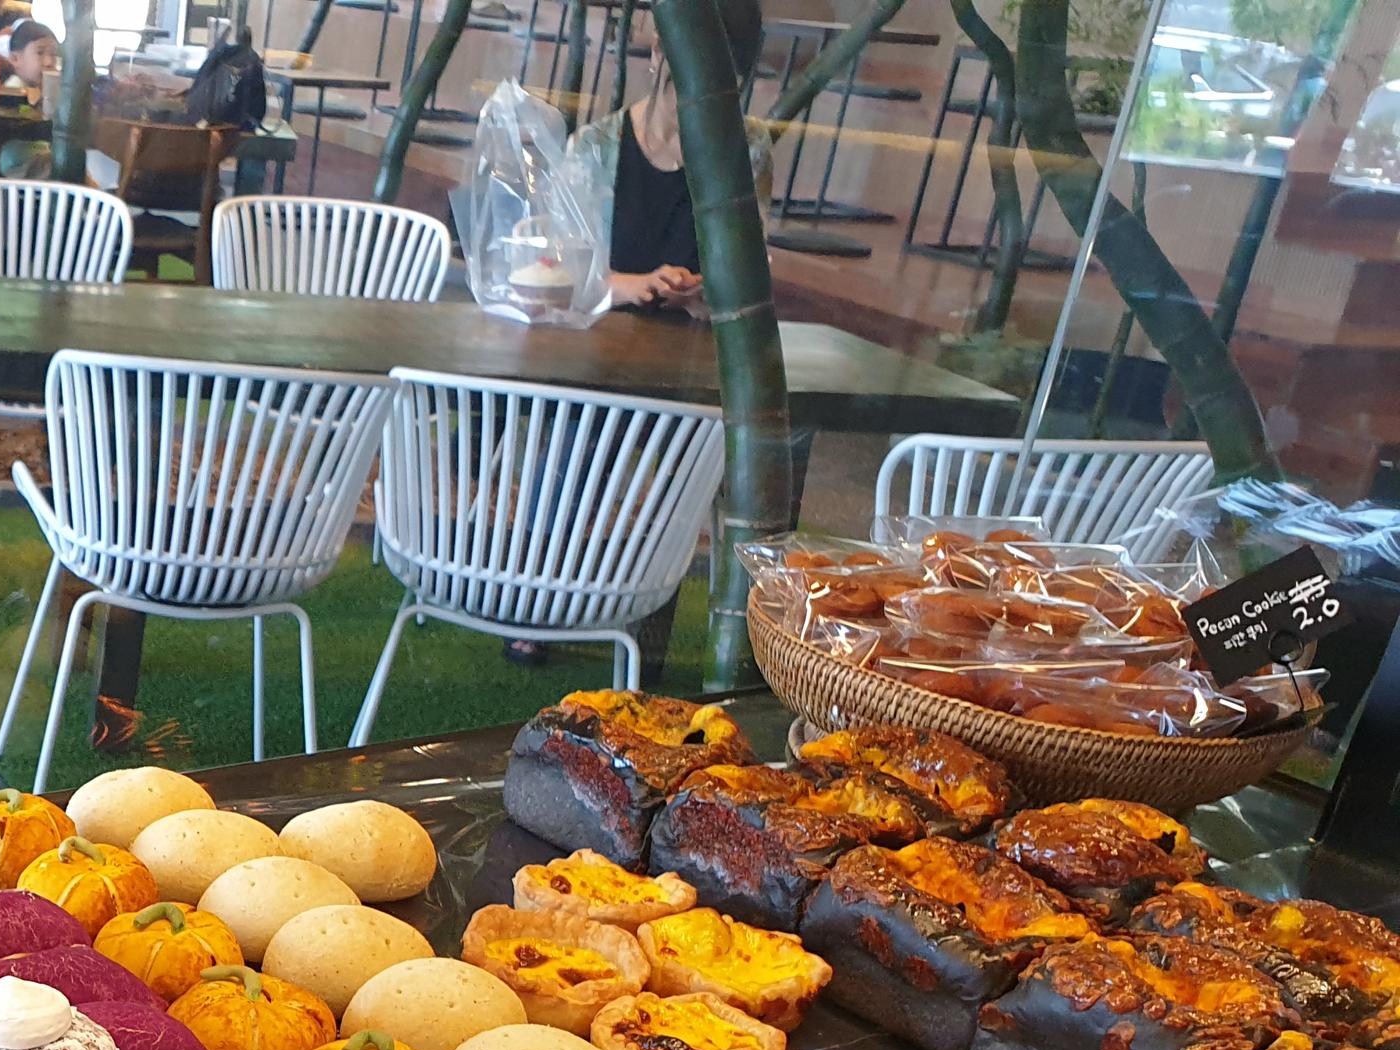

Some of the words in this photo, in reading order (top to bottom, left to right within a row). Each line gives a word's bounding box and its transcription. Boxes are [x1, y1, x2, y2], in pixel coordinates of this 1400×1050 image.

[1197, 614, 1241, 638] Pecan
[1243, 590, 1289, 618] Cookie
[1292, 599, 1341, 631] 2.0
